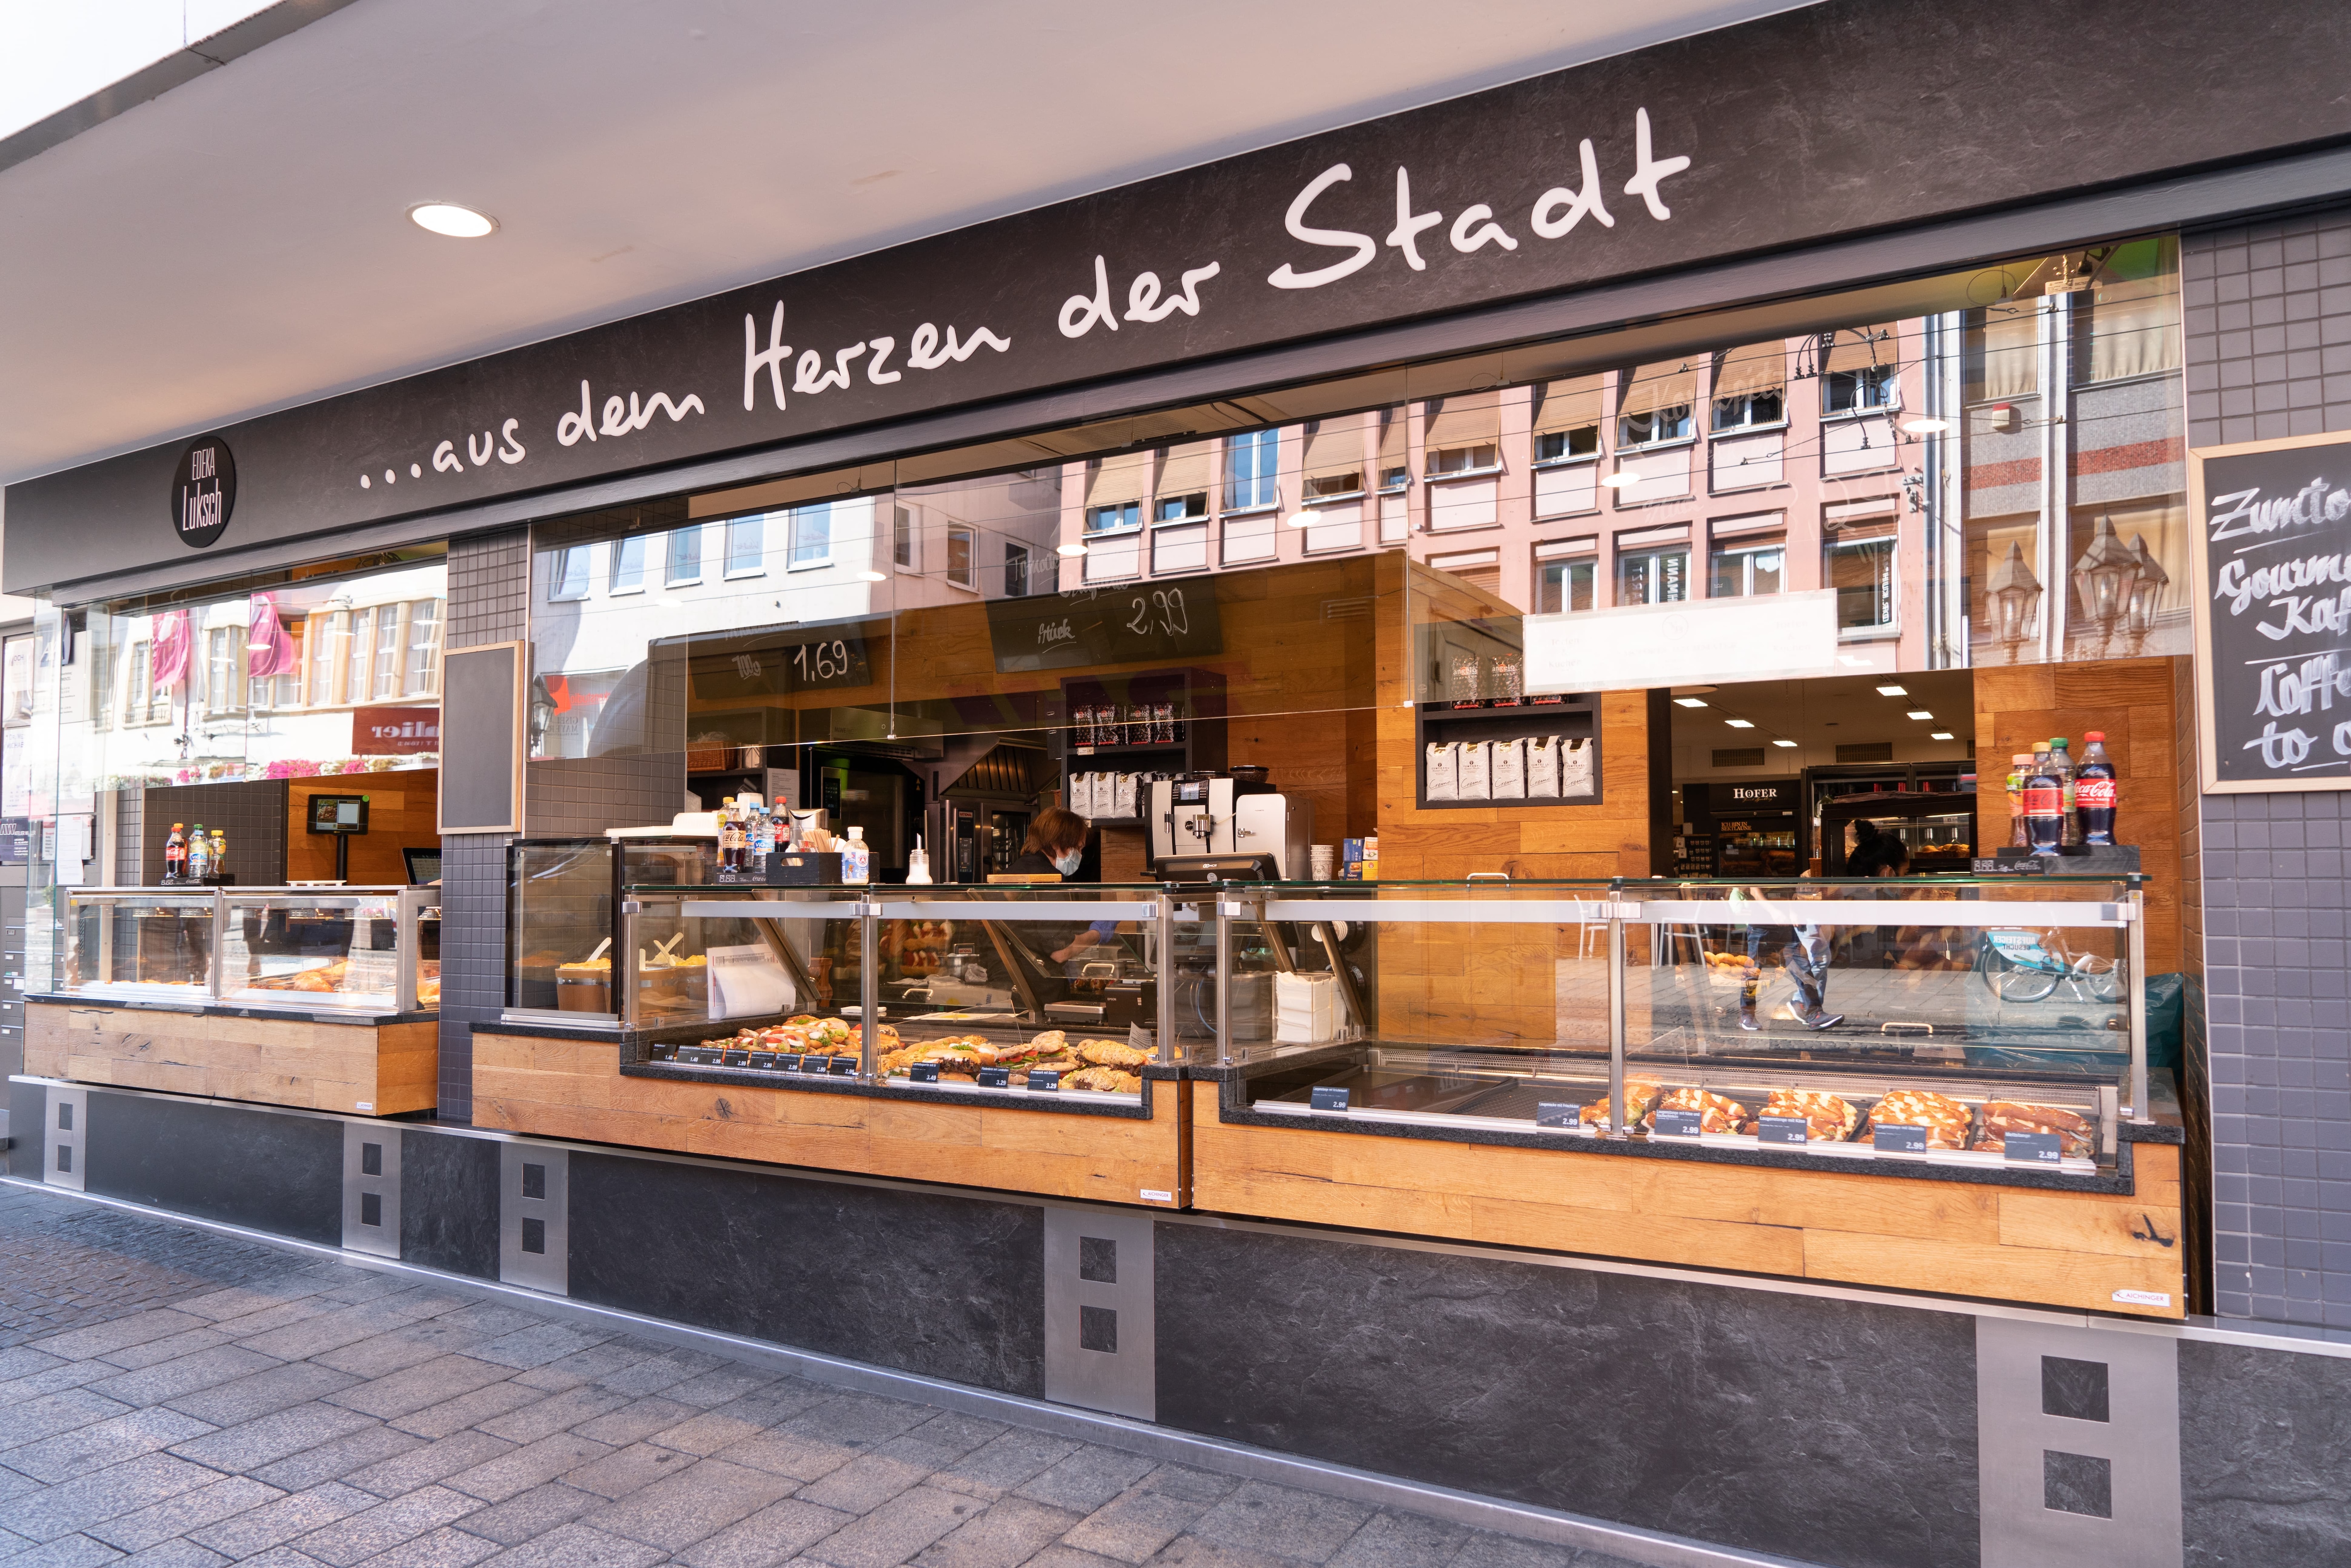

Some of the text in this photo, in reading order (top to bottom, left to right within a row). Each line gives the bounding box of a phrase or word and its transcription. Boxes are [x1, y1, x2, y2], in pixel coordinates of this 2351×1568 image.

[558, 380, 704, 446] dem
[744, 300, 1010, 410] Herzen
[1058, 255, 1220, 338] der
[1268, 108, 1690, 289] Stadt
[192, 447, 215, 480] EDEKA
[183, 479, 221, 530] Luksch
[2209, 476, 2351, 542] Zumto
[1127, 588, 1188, 636] 2,99
[1037, 618, 1075, 644] Stück
[794, 640, 847, 681] 1,69
[1453, 667, 1477, 676] angelo
[1492, 663, 1515, 672] angelo
[2243, 721, 2319, 769] to
[1429, 779, 1452, 789] Creme
[1460, 778, 1483, 788] Creme
[1495, 777, 1518, 788] Creme
[1530, 776, 1552, 786] Creme
[1565, 776, 1588, 787] Creme
[1733, 788, 1777, 798] HOFER
[2074, 781, 2114, 797] Coca-Cola
[1071, 802, 1088, 810] Creme
[1093, 801, 1109, 809] Creme
[1115, 801, 1130, 810] Creme
[2038, 1150, 2059, 1159] 2.99
[2126, 1293, 2164, 1301] AICHINGER
